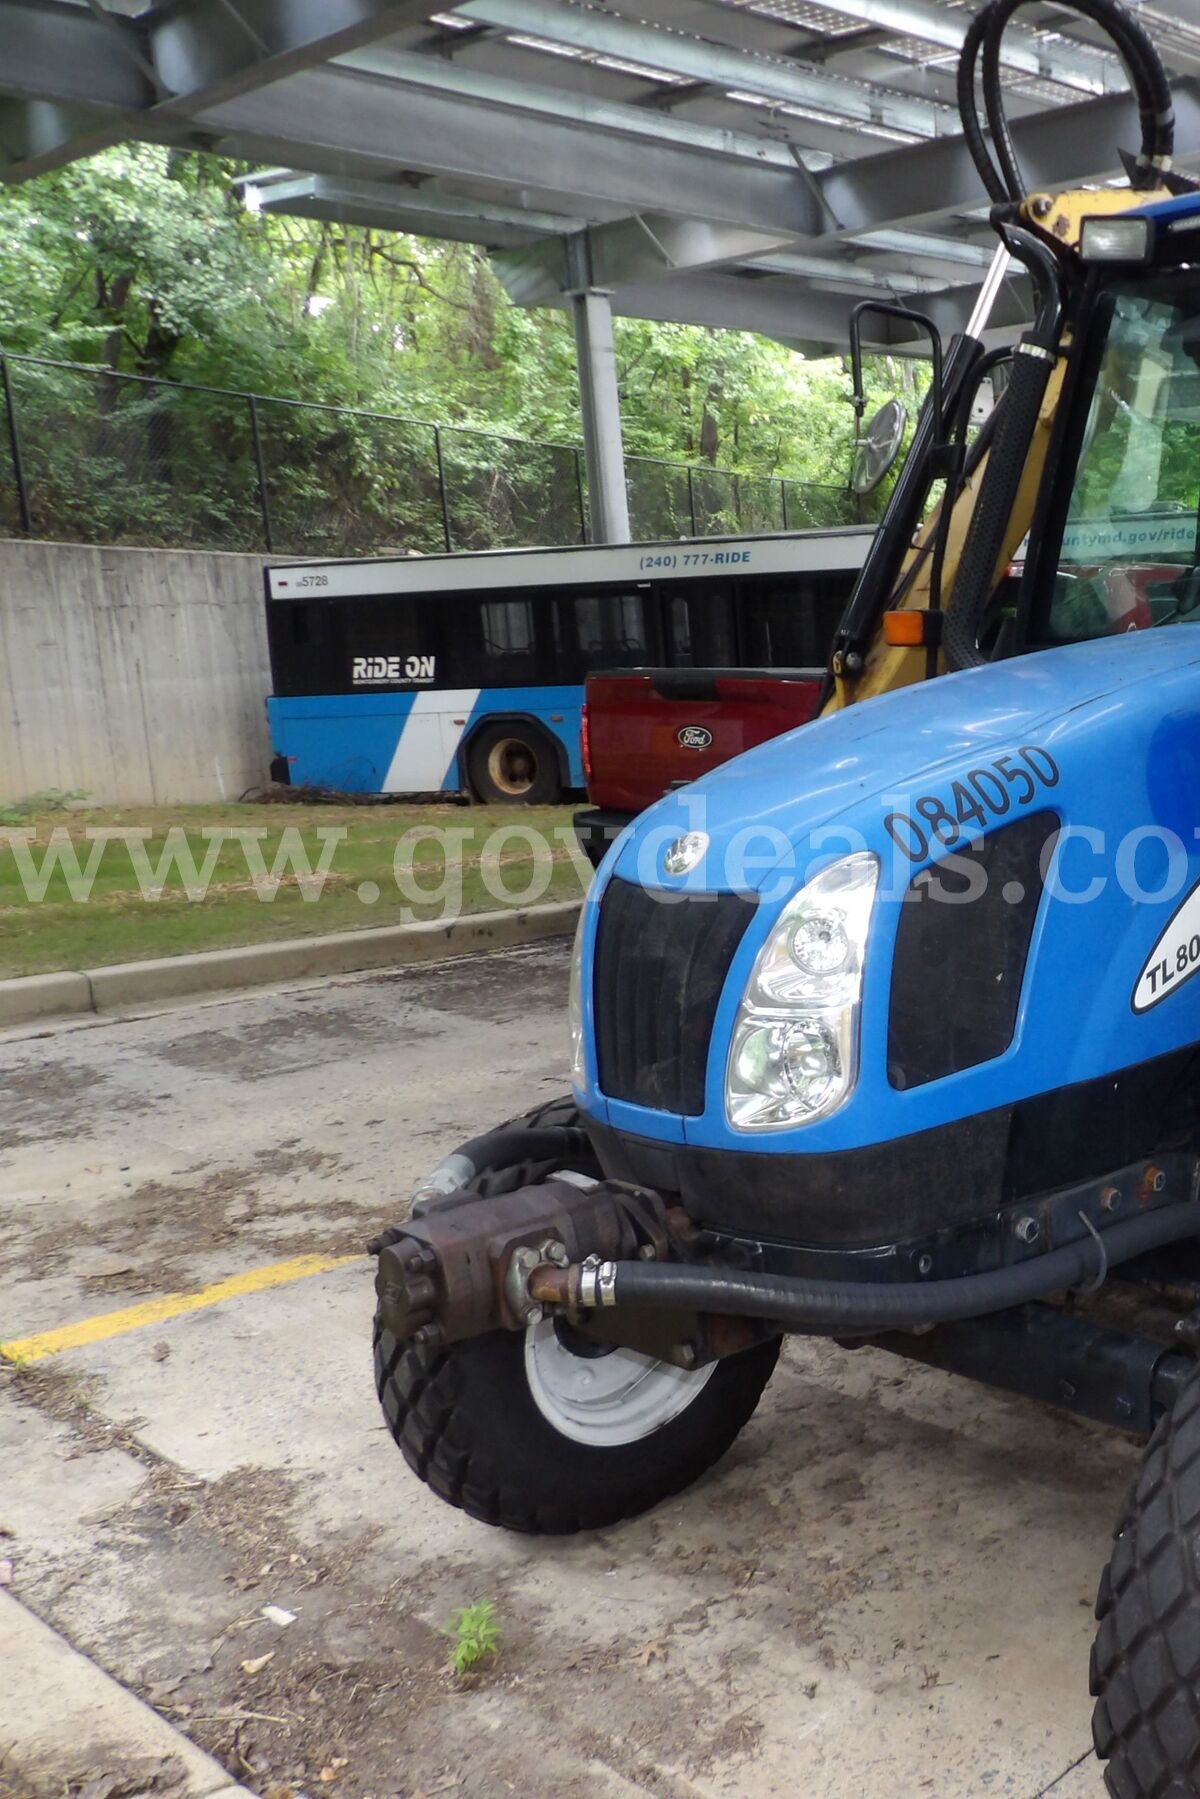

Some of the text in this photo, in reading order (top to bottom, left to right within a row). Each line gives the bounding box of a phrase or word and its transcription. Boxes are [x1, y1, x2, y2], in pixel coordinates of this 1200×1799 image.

[640, 551, 751, 570] (240) 777-RIDE
[405, 655, 436, 678] ON
[683, 729, 706, 745] Ford
[884, 746, 1060, 863] 084050
